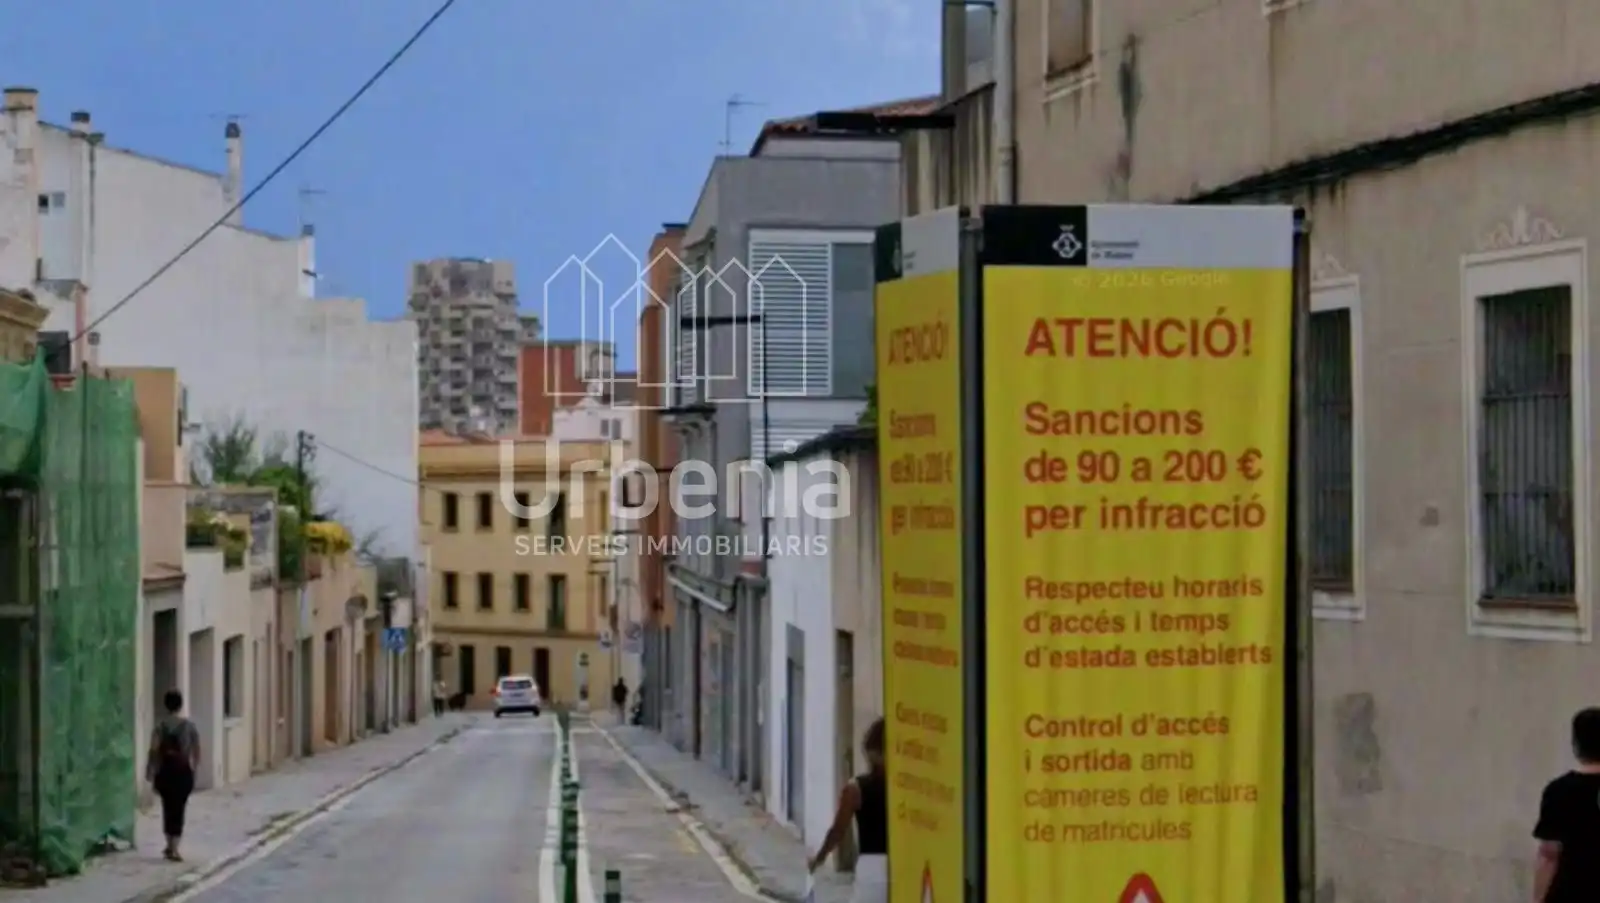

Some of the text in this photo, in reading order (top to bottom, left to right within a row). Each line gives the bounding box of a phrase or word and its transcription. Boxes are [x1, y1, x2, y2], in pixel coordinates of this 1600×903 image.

[1024, 306, 1253, 359] ATENCIÓ!
[1024, 402, 1204, 436] Sancions
[1024, 448, 1262, 483] de 90 a 200 €
[1024, 494, 1266, 538] per infracció
[1024, 573, 1264, 604] Respecteu horaris
[1023, 608, 1230, 635] d'accés i temps
[1023, 642, 1273, 668] d'estada establerts
[1024, 710, 1230, 738] Control d'accés
[1024, 749, 1195, 773] i sortida amb
[1139, 783, 1170, 806] de
[1178, 782, 1258, 804] lectura
[1024, 819, 1055, 843] de
